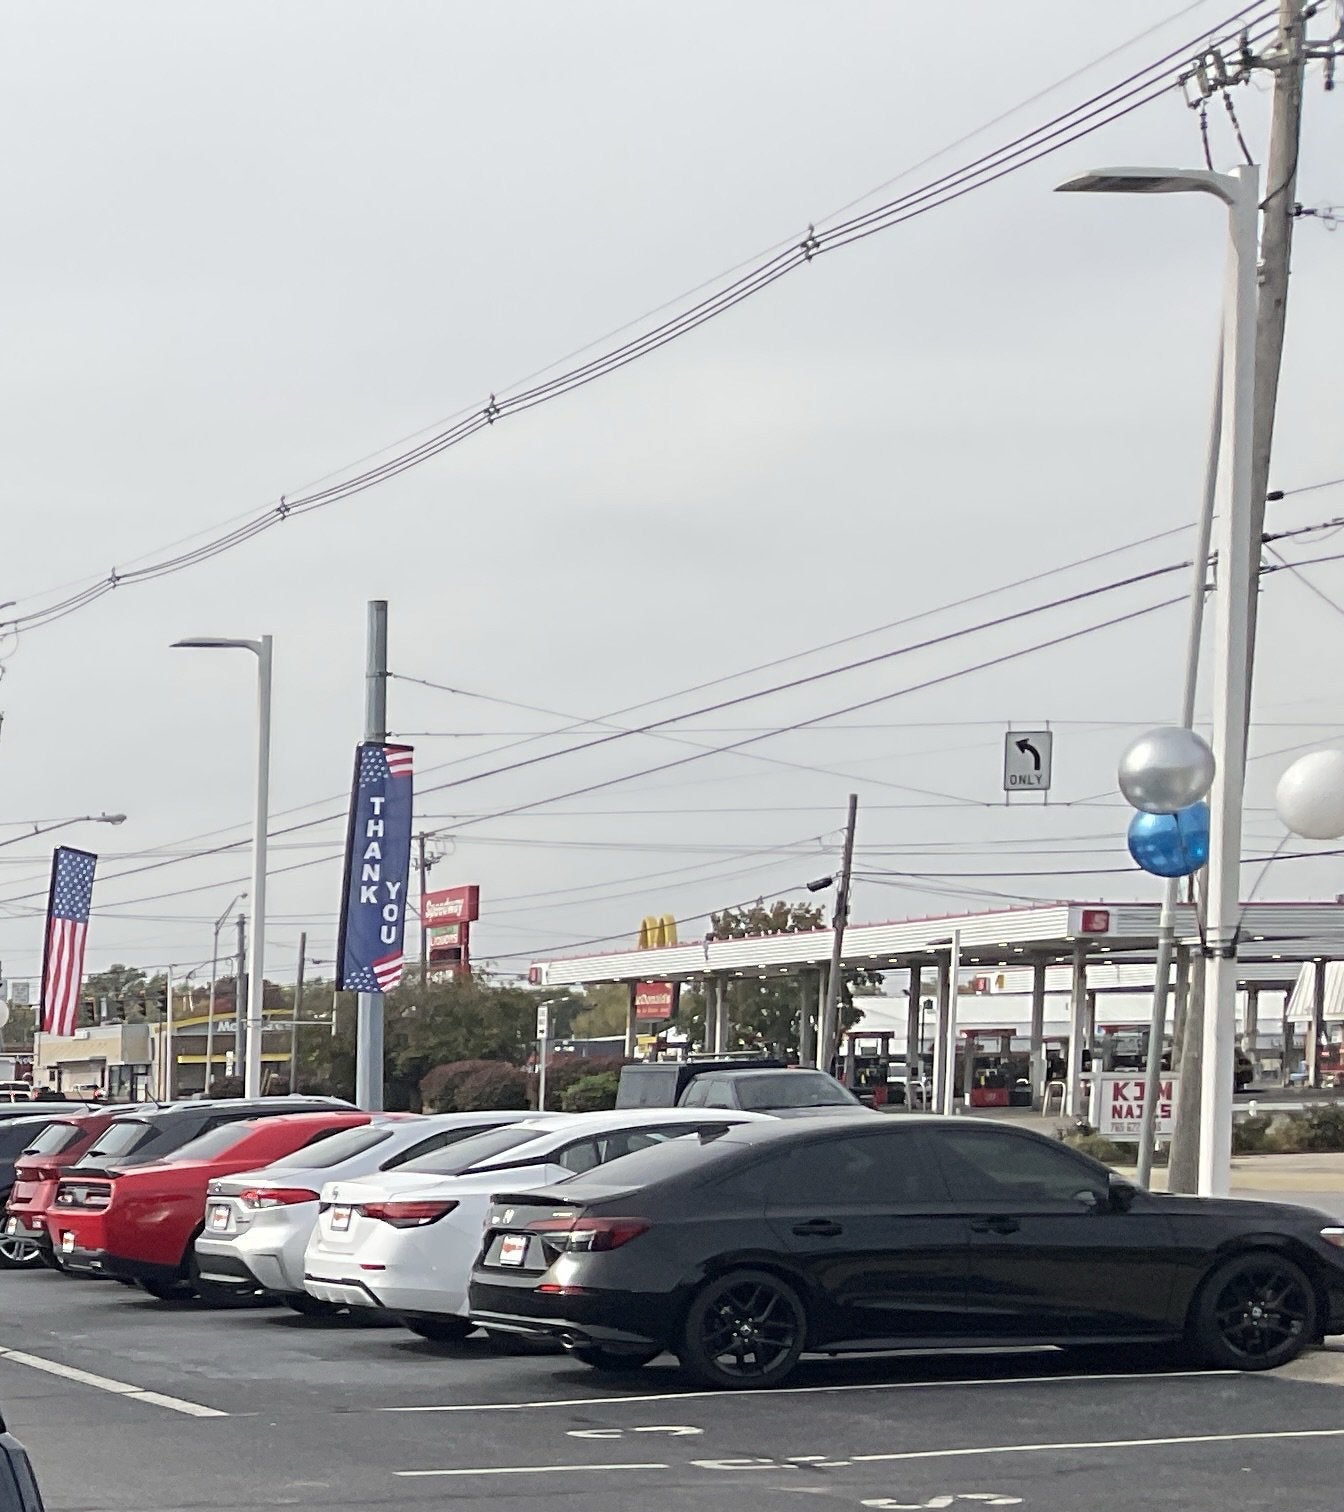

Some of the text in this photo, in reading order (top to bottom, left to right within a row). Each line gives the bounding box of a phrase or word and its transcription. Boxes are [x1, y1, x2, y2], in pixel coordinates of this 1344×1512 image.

[1009, 774, 1043, 785] ONLY
[360, 796, 385, 904] THANK
[380, 880, 402, 945] YOU
[1112, 1103, 1172, 1119] NAIS
